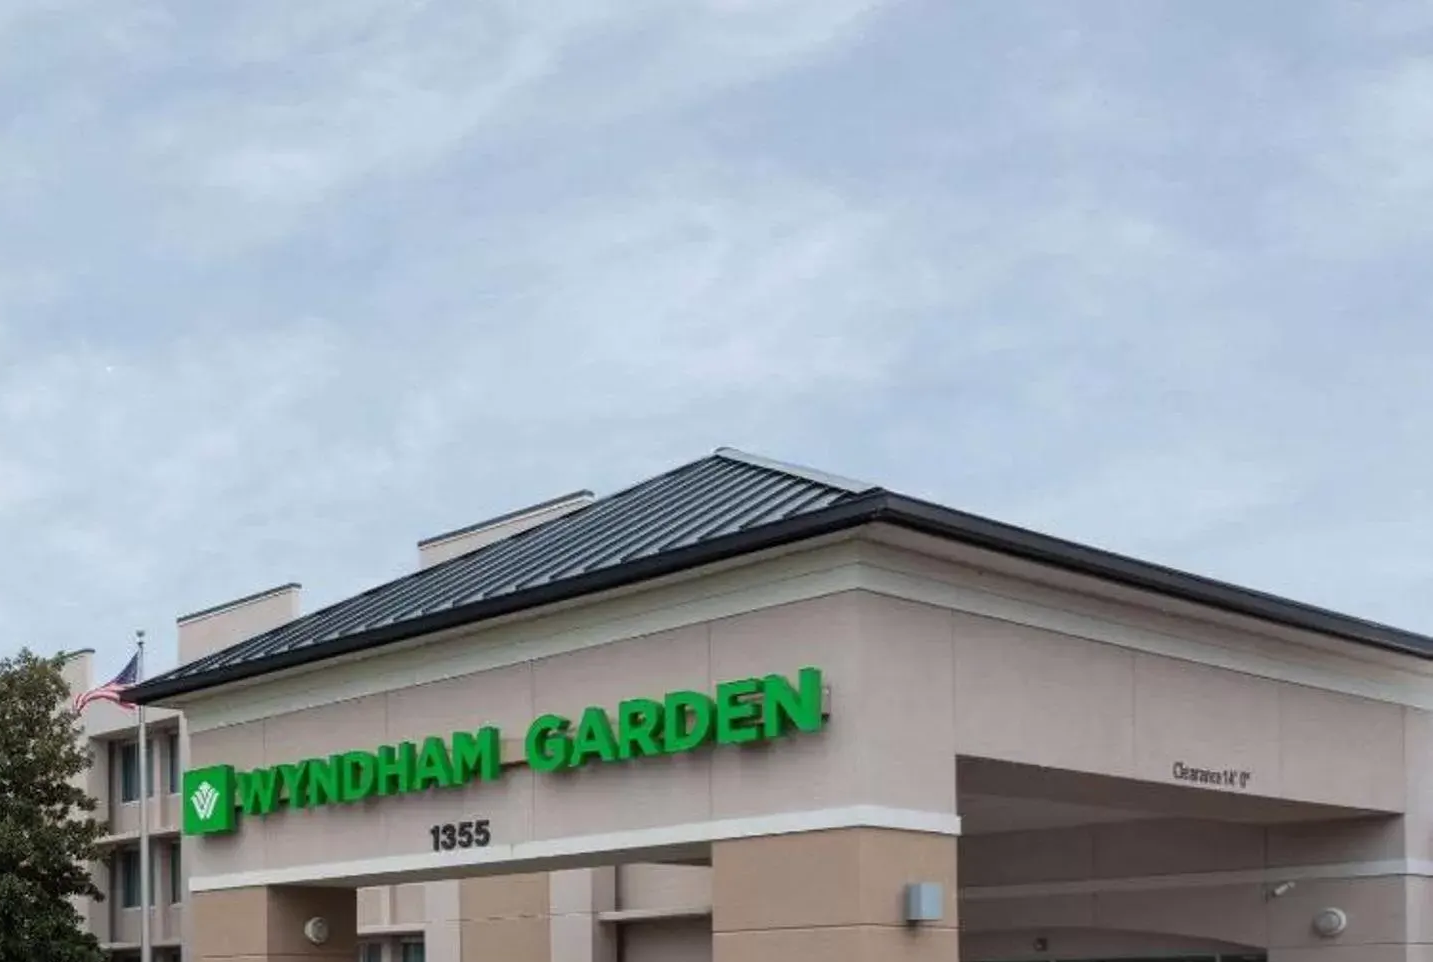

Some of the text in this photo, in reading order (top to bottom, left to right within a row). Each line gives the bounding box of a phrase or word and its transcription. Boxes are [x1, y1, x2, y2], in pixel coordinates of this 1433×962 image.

[237, 667, 822, 815] WYNDHAM GARDEN
[430, 819, 491, 852] 1355
